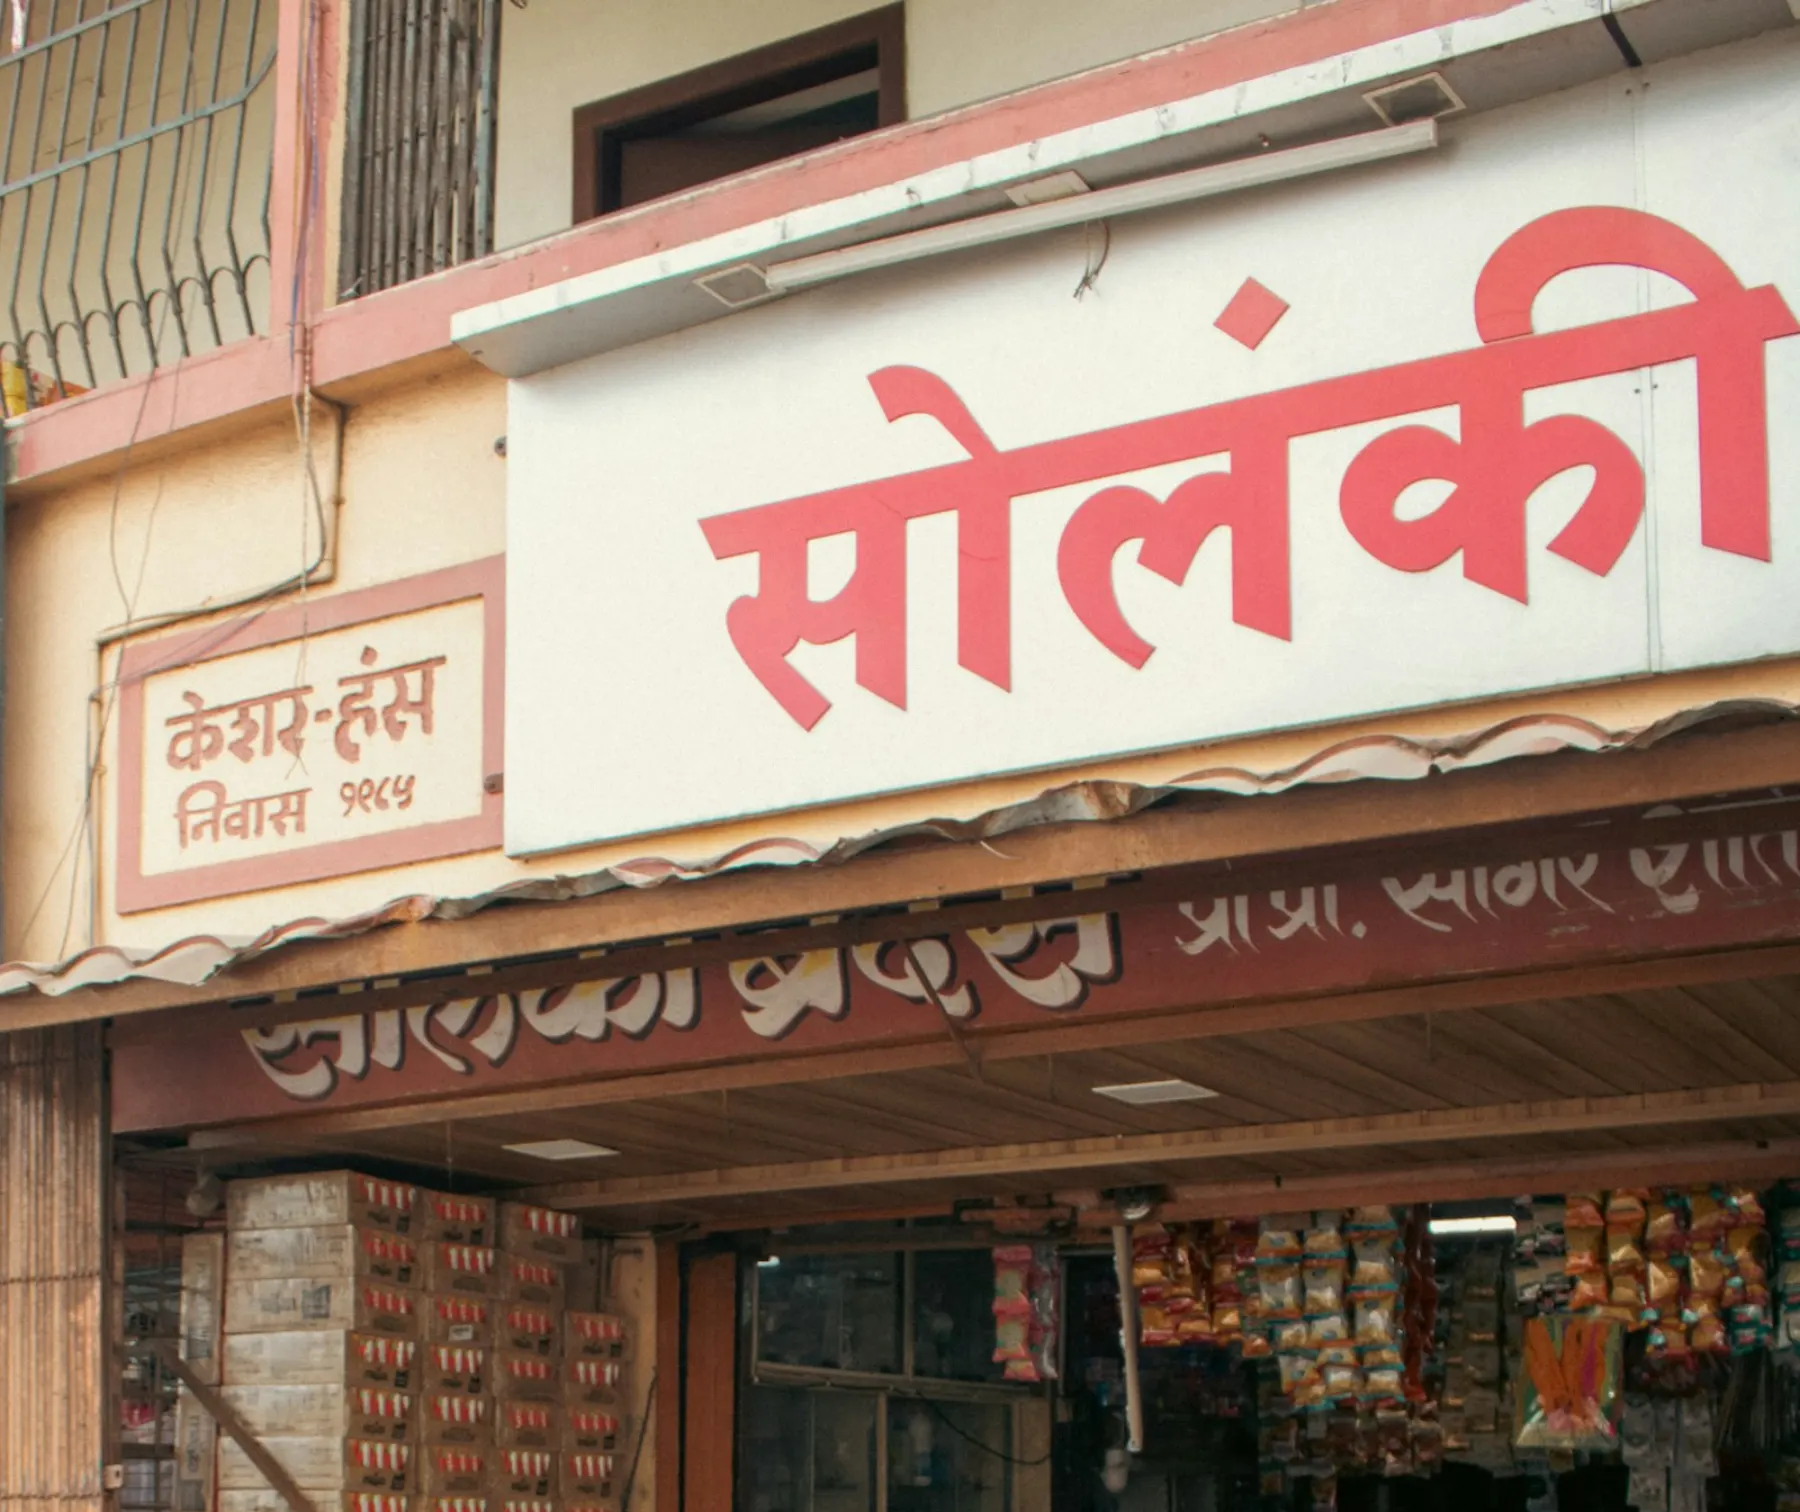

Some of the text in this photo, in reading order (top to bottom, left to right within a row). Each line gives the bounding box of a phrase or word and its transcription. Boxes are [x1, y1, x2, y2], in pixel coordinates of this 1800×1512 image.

[698, 206, 1800, 731] सोलंकी
[165, 646, 447, 771] केशर-हंस
[173, 779, 313, 849] निवास
